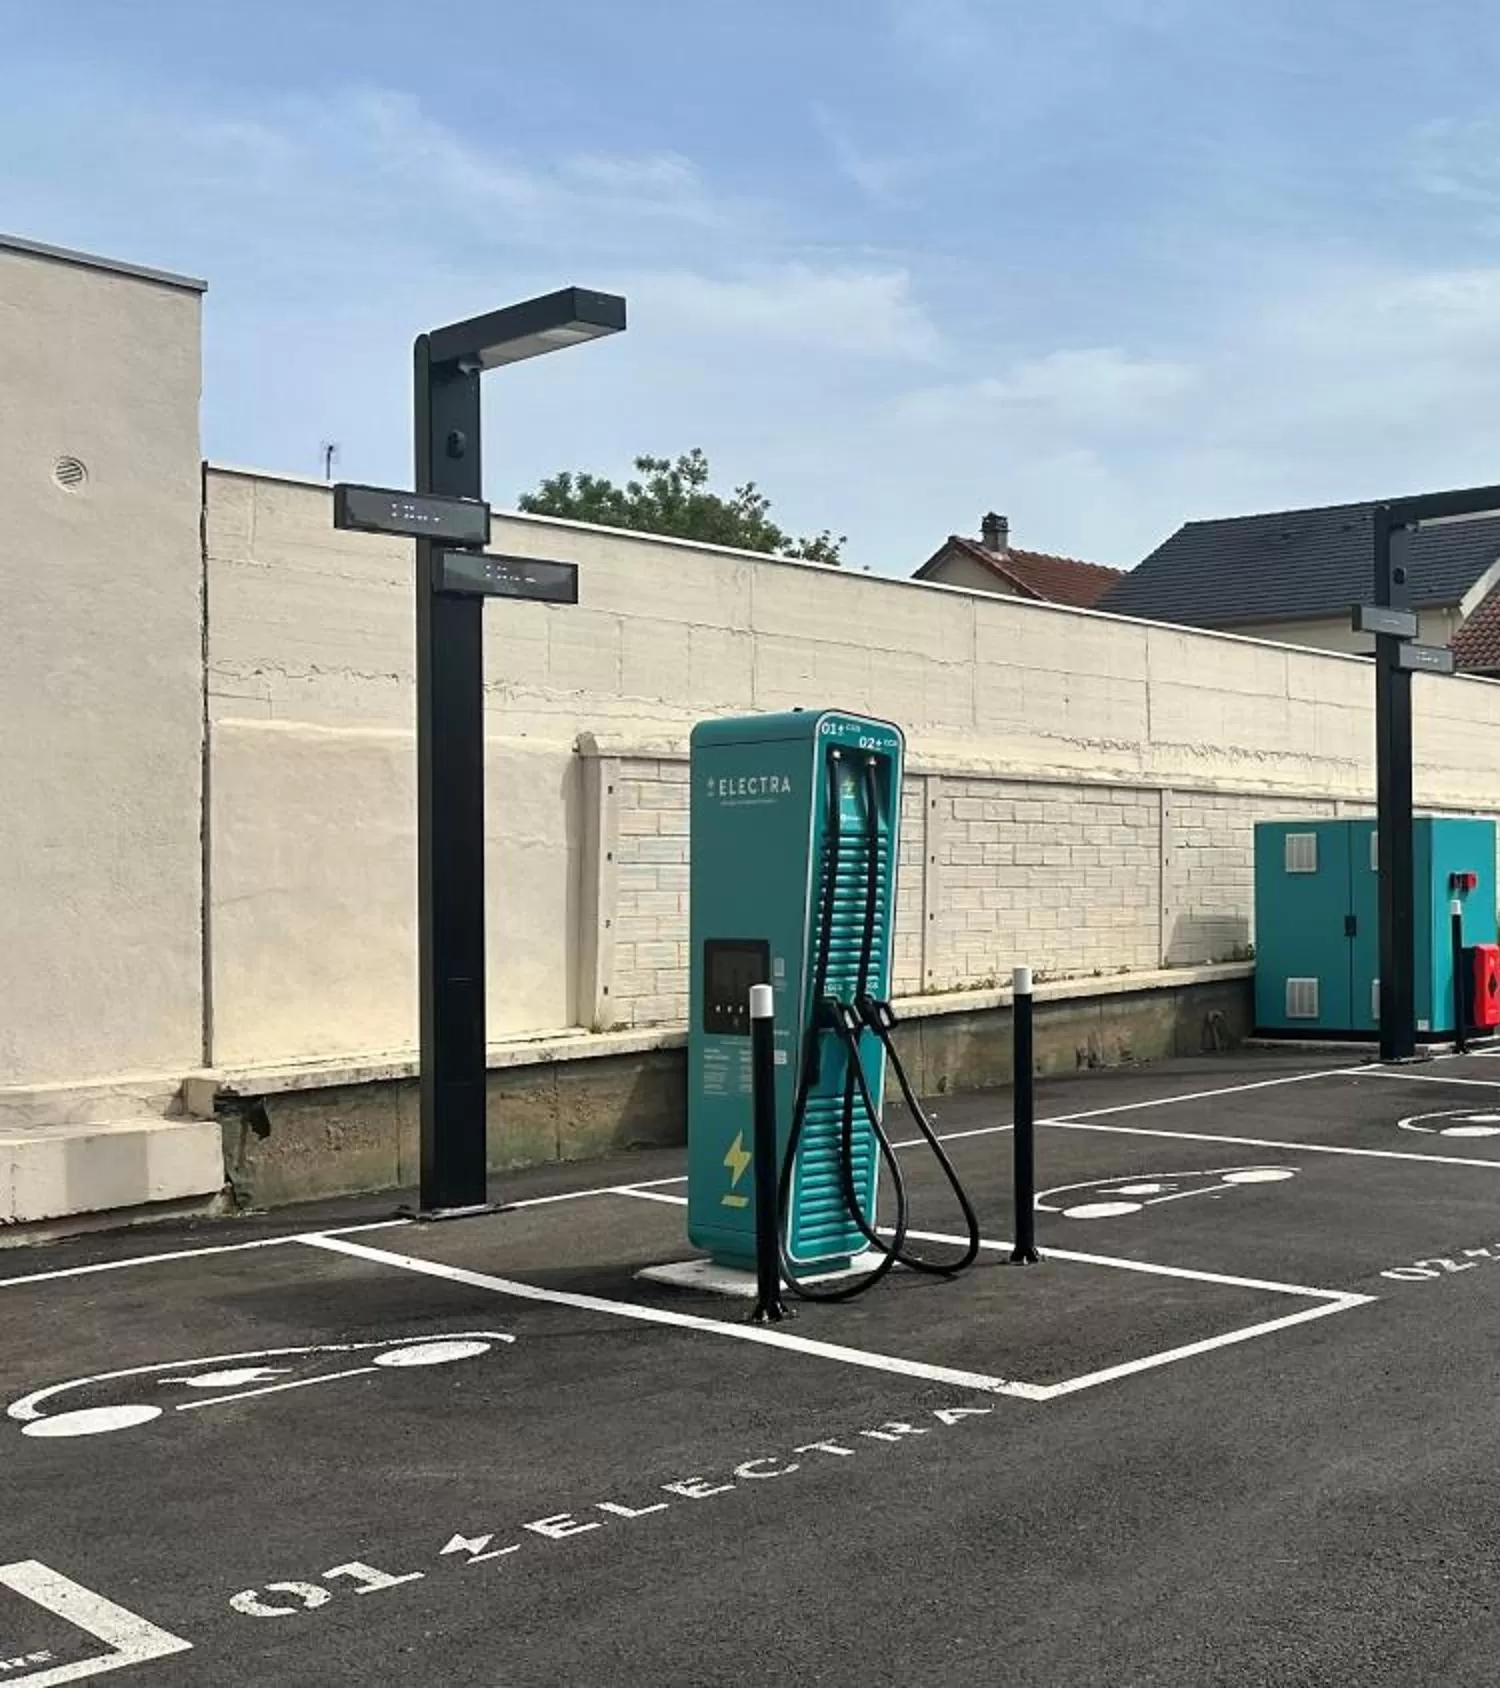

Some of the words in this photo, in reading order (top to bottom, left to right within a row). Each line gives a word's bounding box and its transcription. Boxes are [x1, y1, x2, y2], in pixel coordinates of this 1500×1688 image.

[821, 722, 837, 735] 01
[859, 735, 876, 749] 02
[719, 775, 792, 796] ELECTRA
[1380, 1258, 1479, 1281] 02
[229, 1560, 426, 1617] 01
[522, 1403, 995, 1539] ELECTRA
